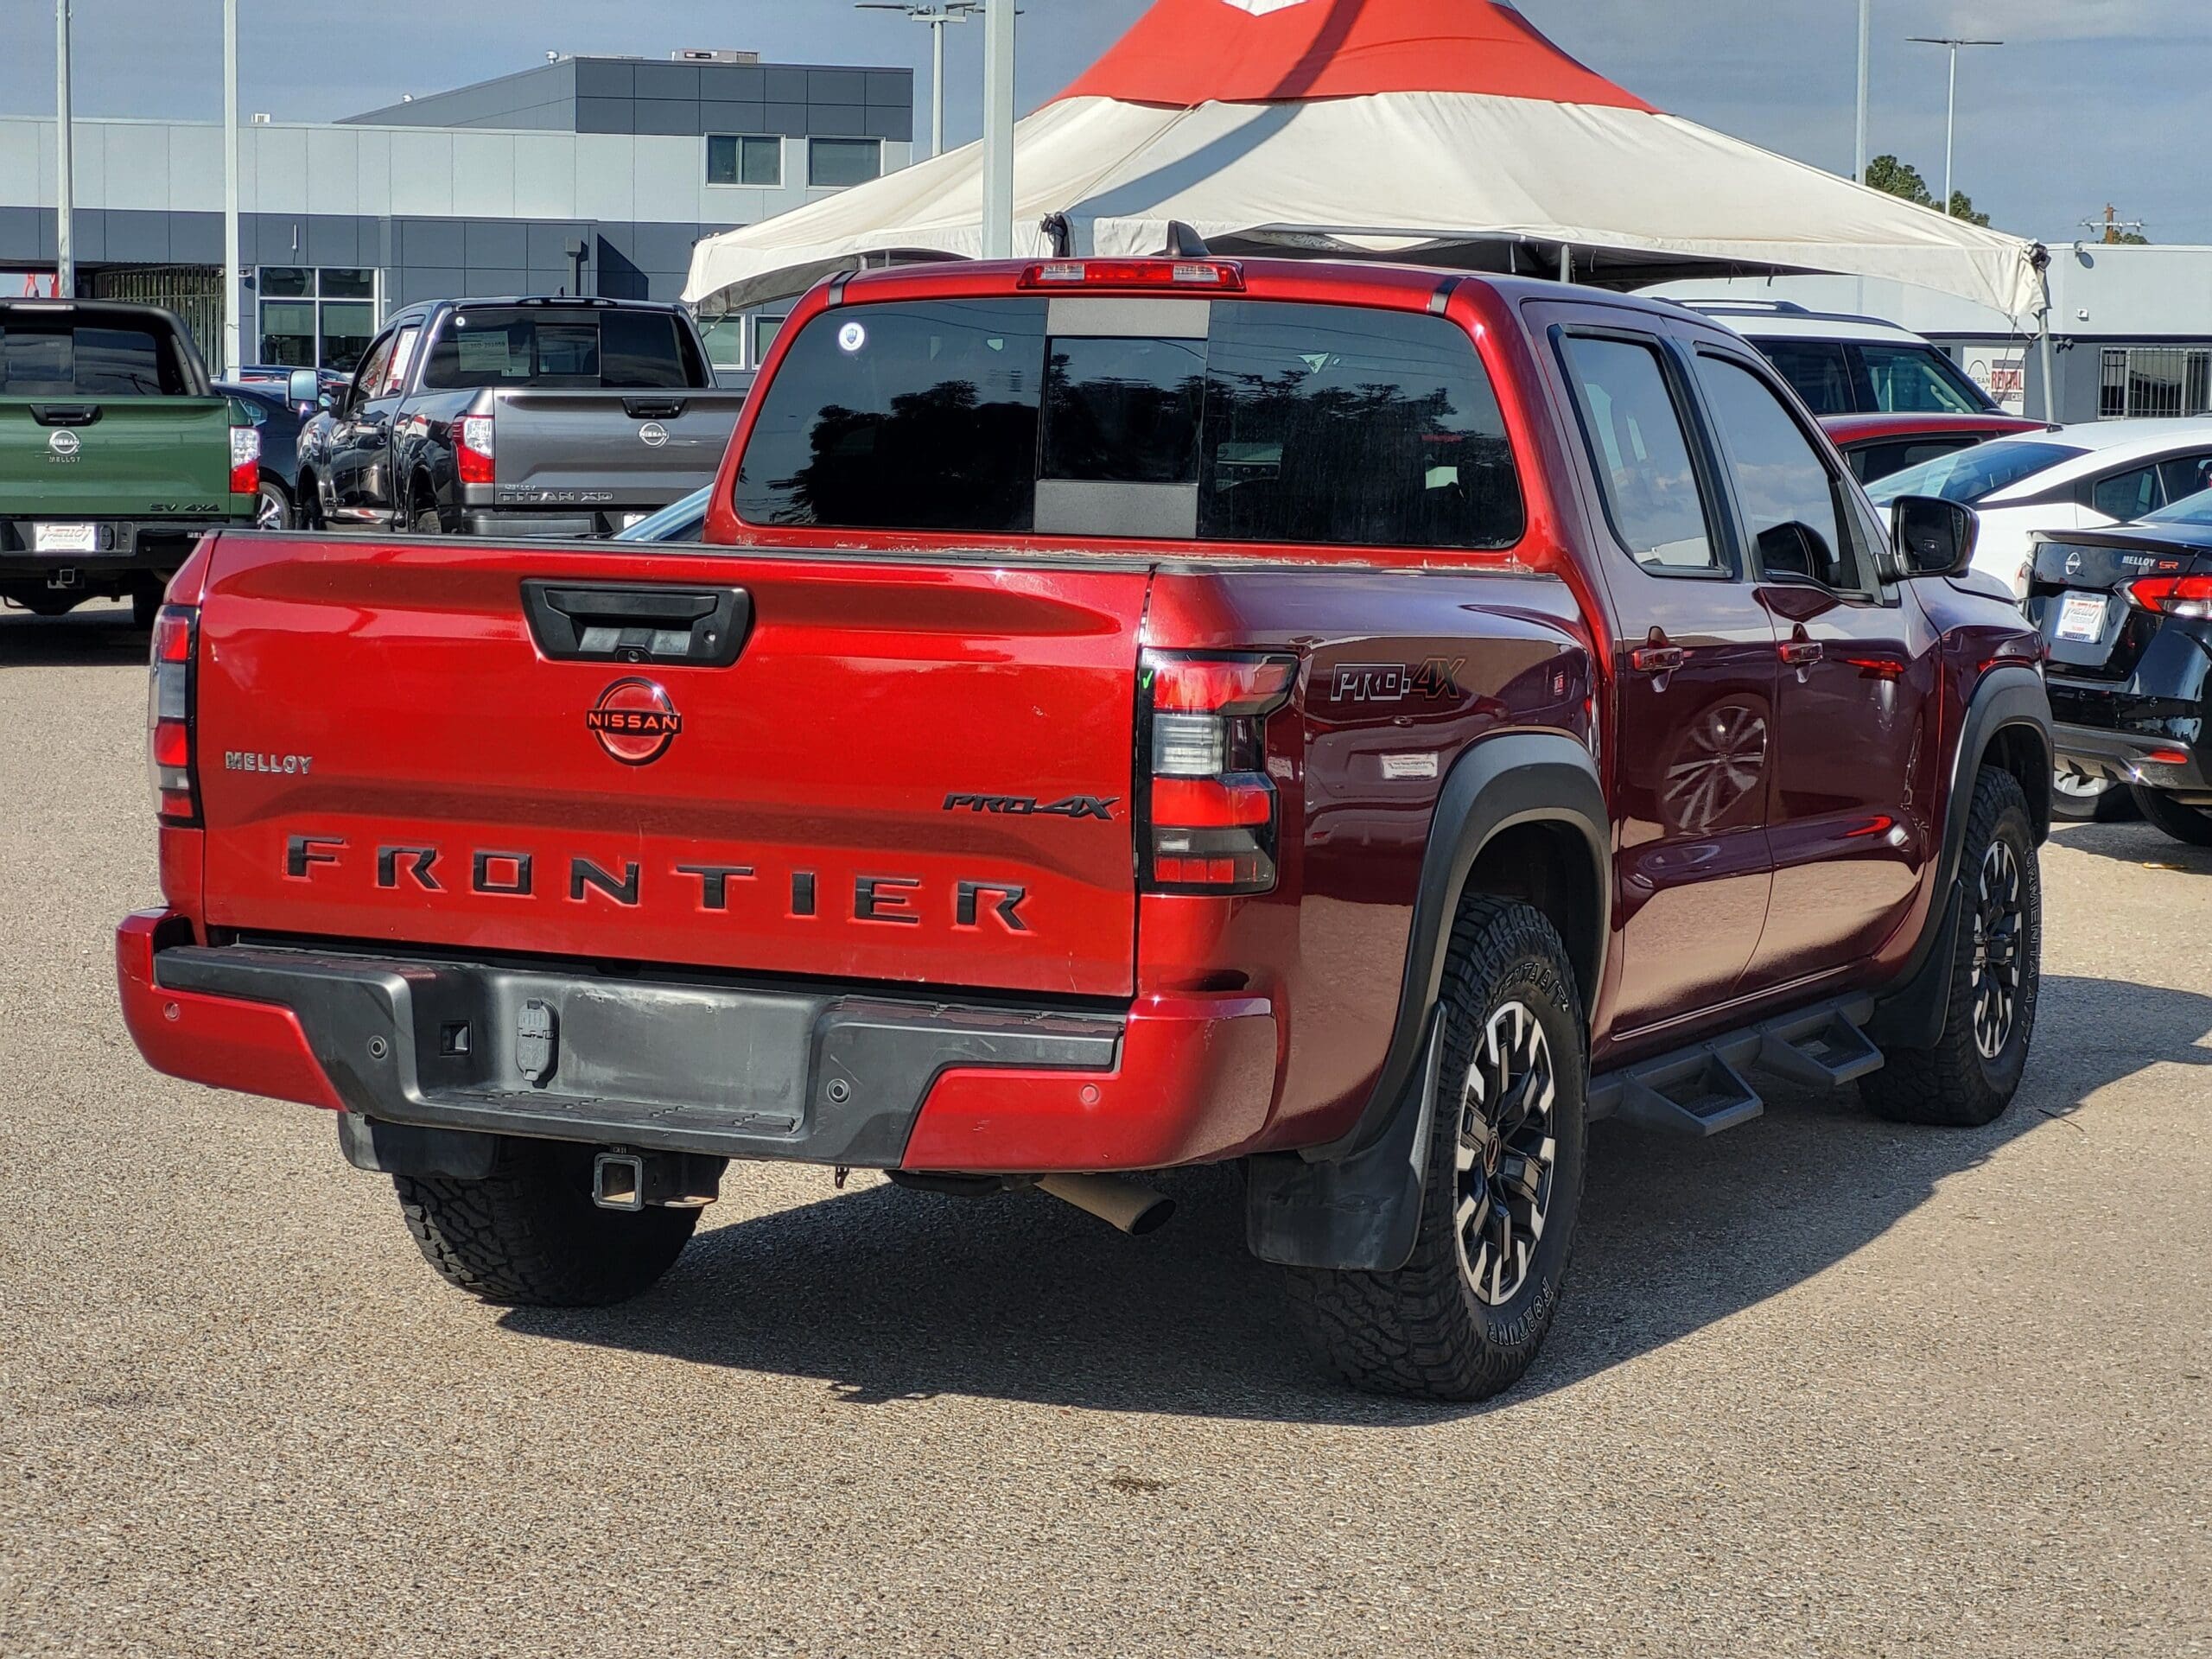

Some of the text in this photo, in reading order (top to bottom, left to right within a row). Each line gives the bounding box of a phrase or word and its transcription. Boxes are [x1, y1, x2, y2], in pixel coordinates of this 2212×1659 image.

[1991, 371, 2024, 391] RENTAL
[499, 492, 613, 501] TITAN XD
[2121, 556, 2157, 567] MELLOY
[588, 712, 677, 729] NISSAN
[226, 751, 312, 774] MELLOY
[944, 793, 1121, 820] PRO-4X
[286, 836, 1028, 931] FRONTIER
[1488, 1275, 1554, 1345] FORTUNE
